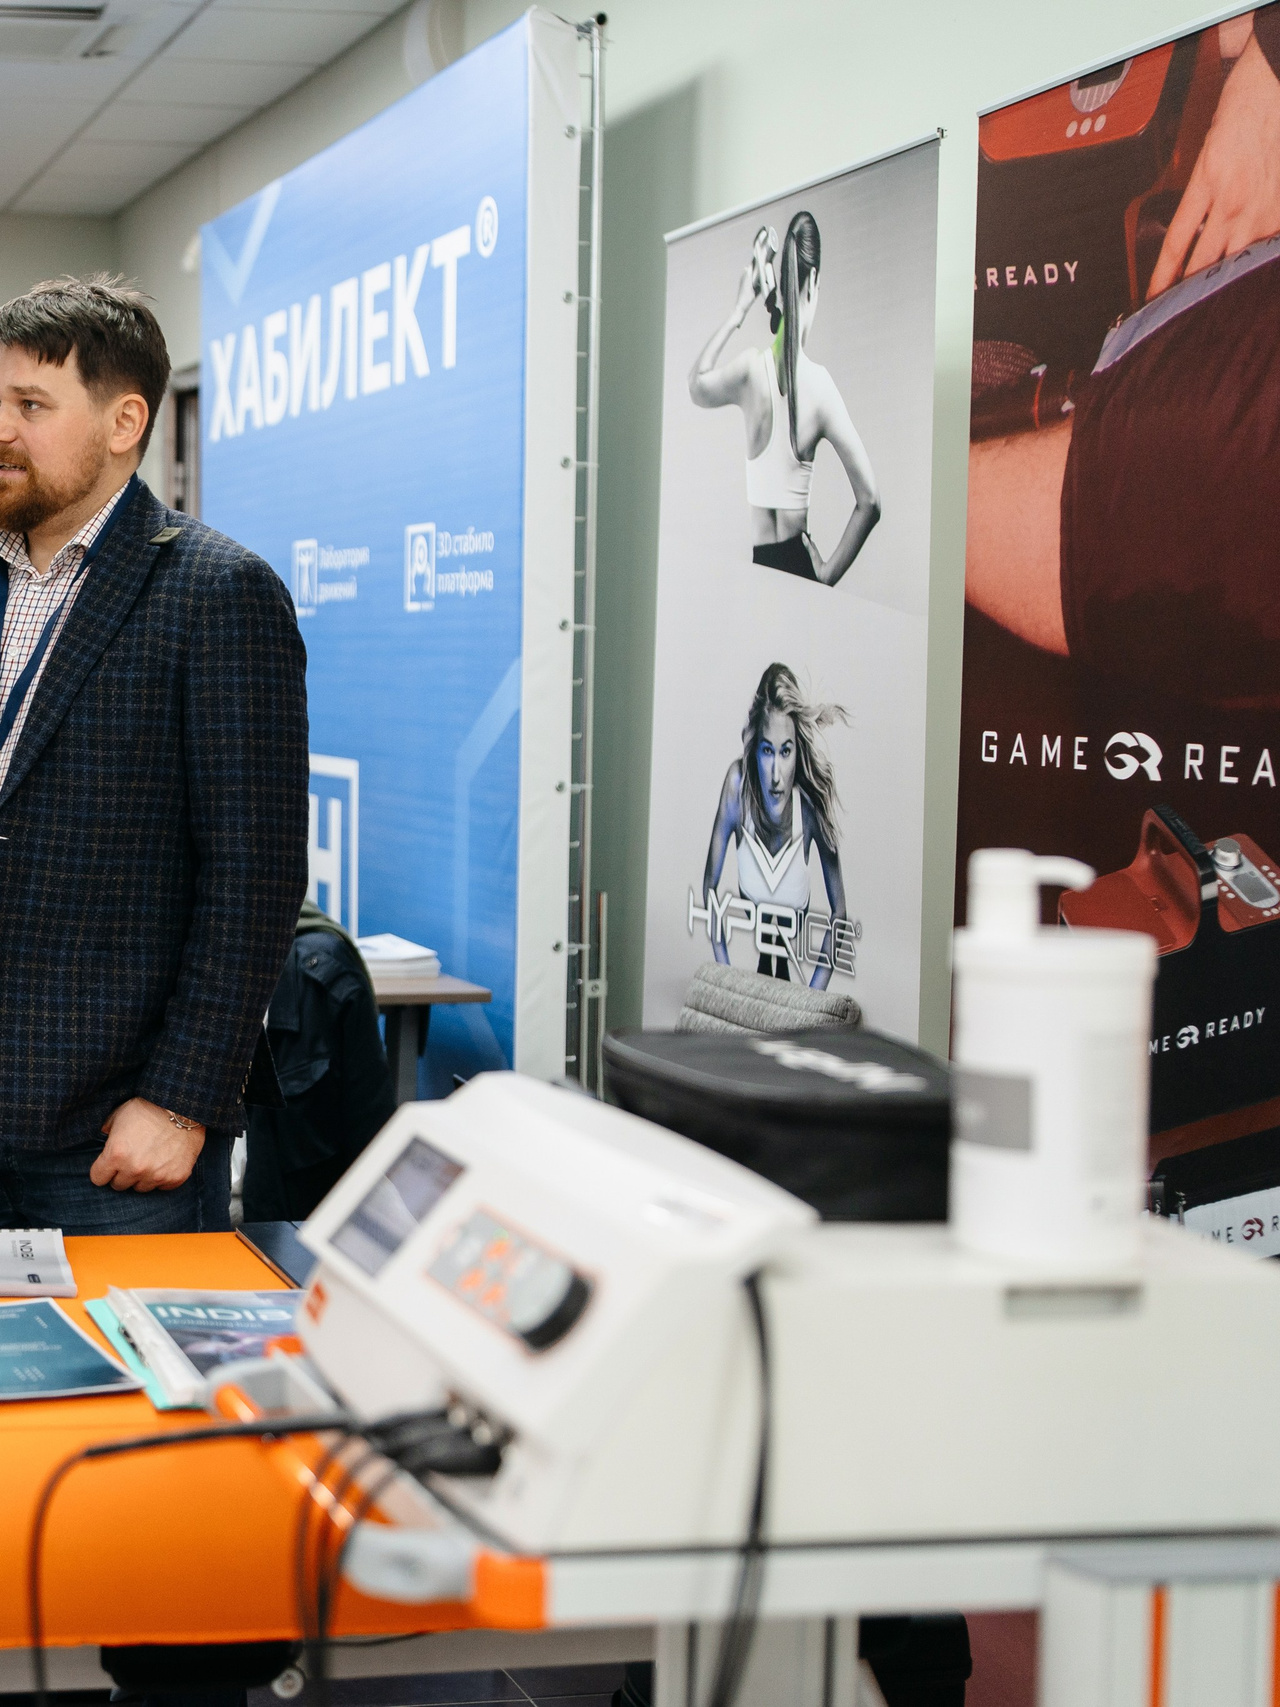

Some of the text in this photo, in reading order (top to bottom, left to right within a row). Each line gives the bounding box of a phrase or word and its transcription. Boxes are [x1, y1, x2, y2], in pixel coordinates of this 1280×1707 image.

[986, 261, 1078, 287] READY
[437, 531, 452, 558] 3D
[437, 565, 494, 597] платформа
[981, 731, 1089, 771] GAME
[1184, 743, 1276, 787] REA
[1205, 1007, 1266, 1039] READY
